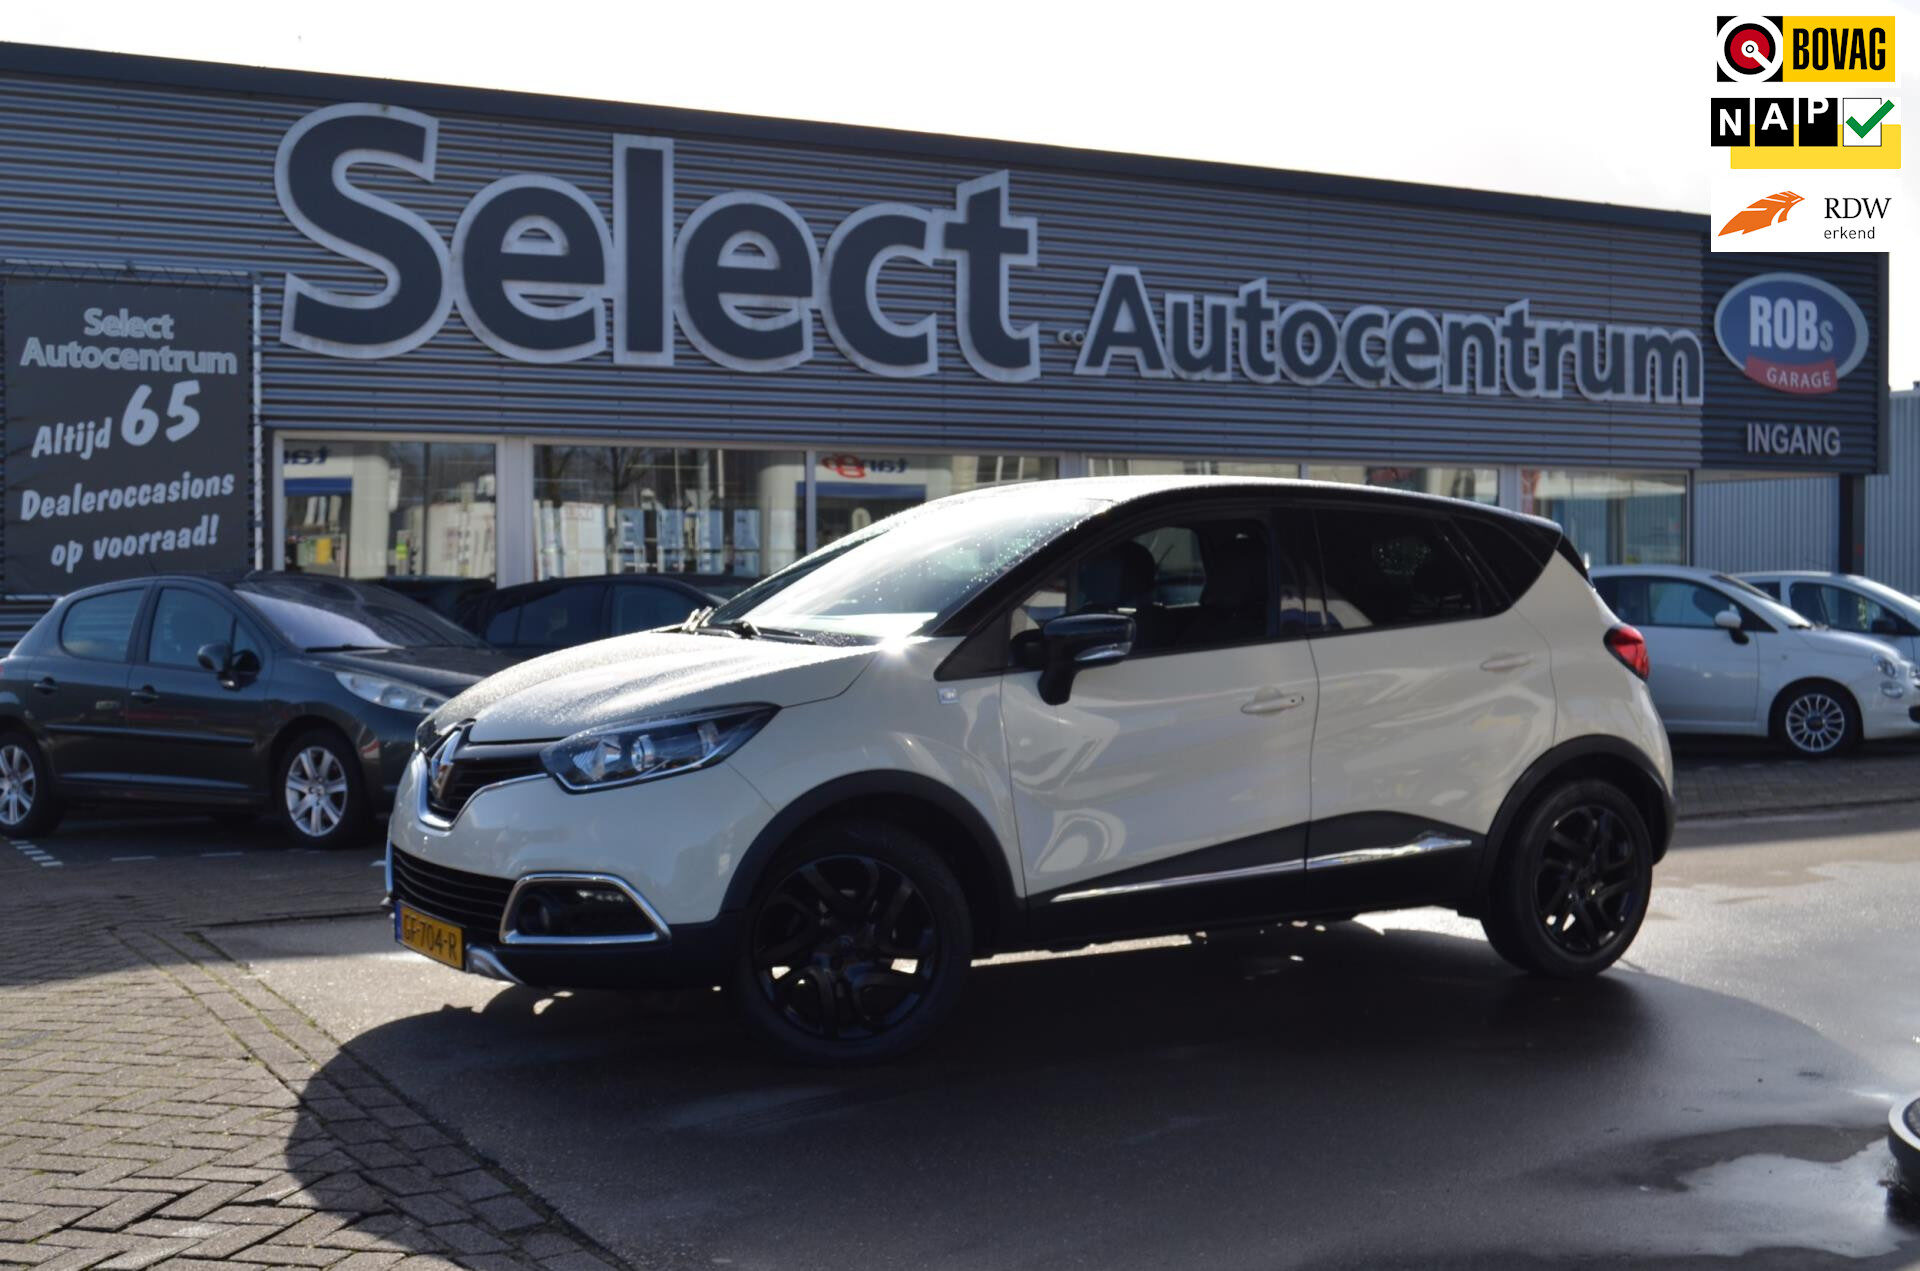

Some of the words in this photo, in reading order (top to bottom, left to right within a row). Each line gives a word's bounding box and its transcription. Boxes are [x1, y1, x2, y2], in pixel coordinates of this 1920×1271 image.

[274, 102, 1041, 383] Select
[1074, 265, 1704, 406] Autocentrum
[83, 308, 174, 339] Select
[20, 337, 237, 375] Autocentrum
[1766, 367, 1832, 388] GARAGE
[31, 416, 113, 460] Altijd
[121, 379, 200, 446] 65
[1746, 423, 1841, 456] INGANG
[20, 471, 235, 521] Dealeroccasions
[51, 541, 83, 573] op
[93, 514, 220, 560] voorraad!
